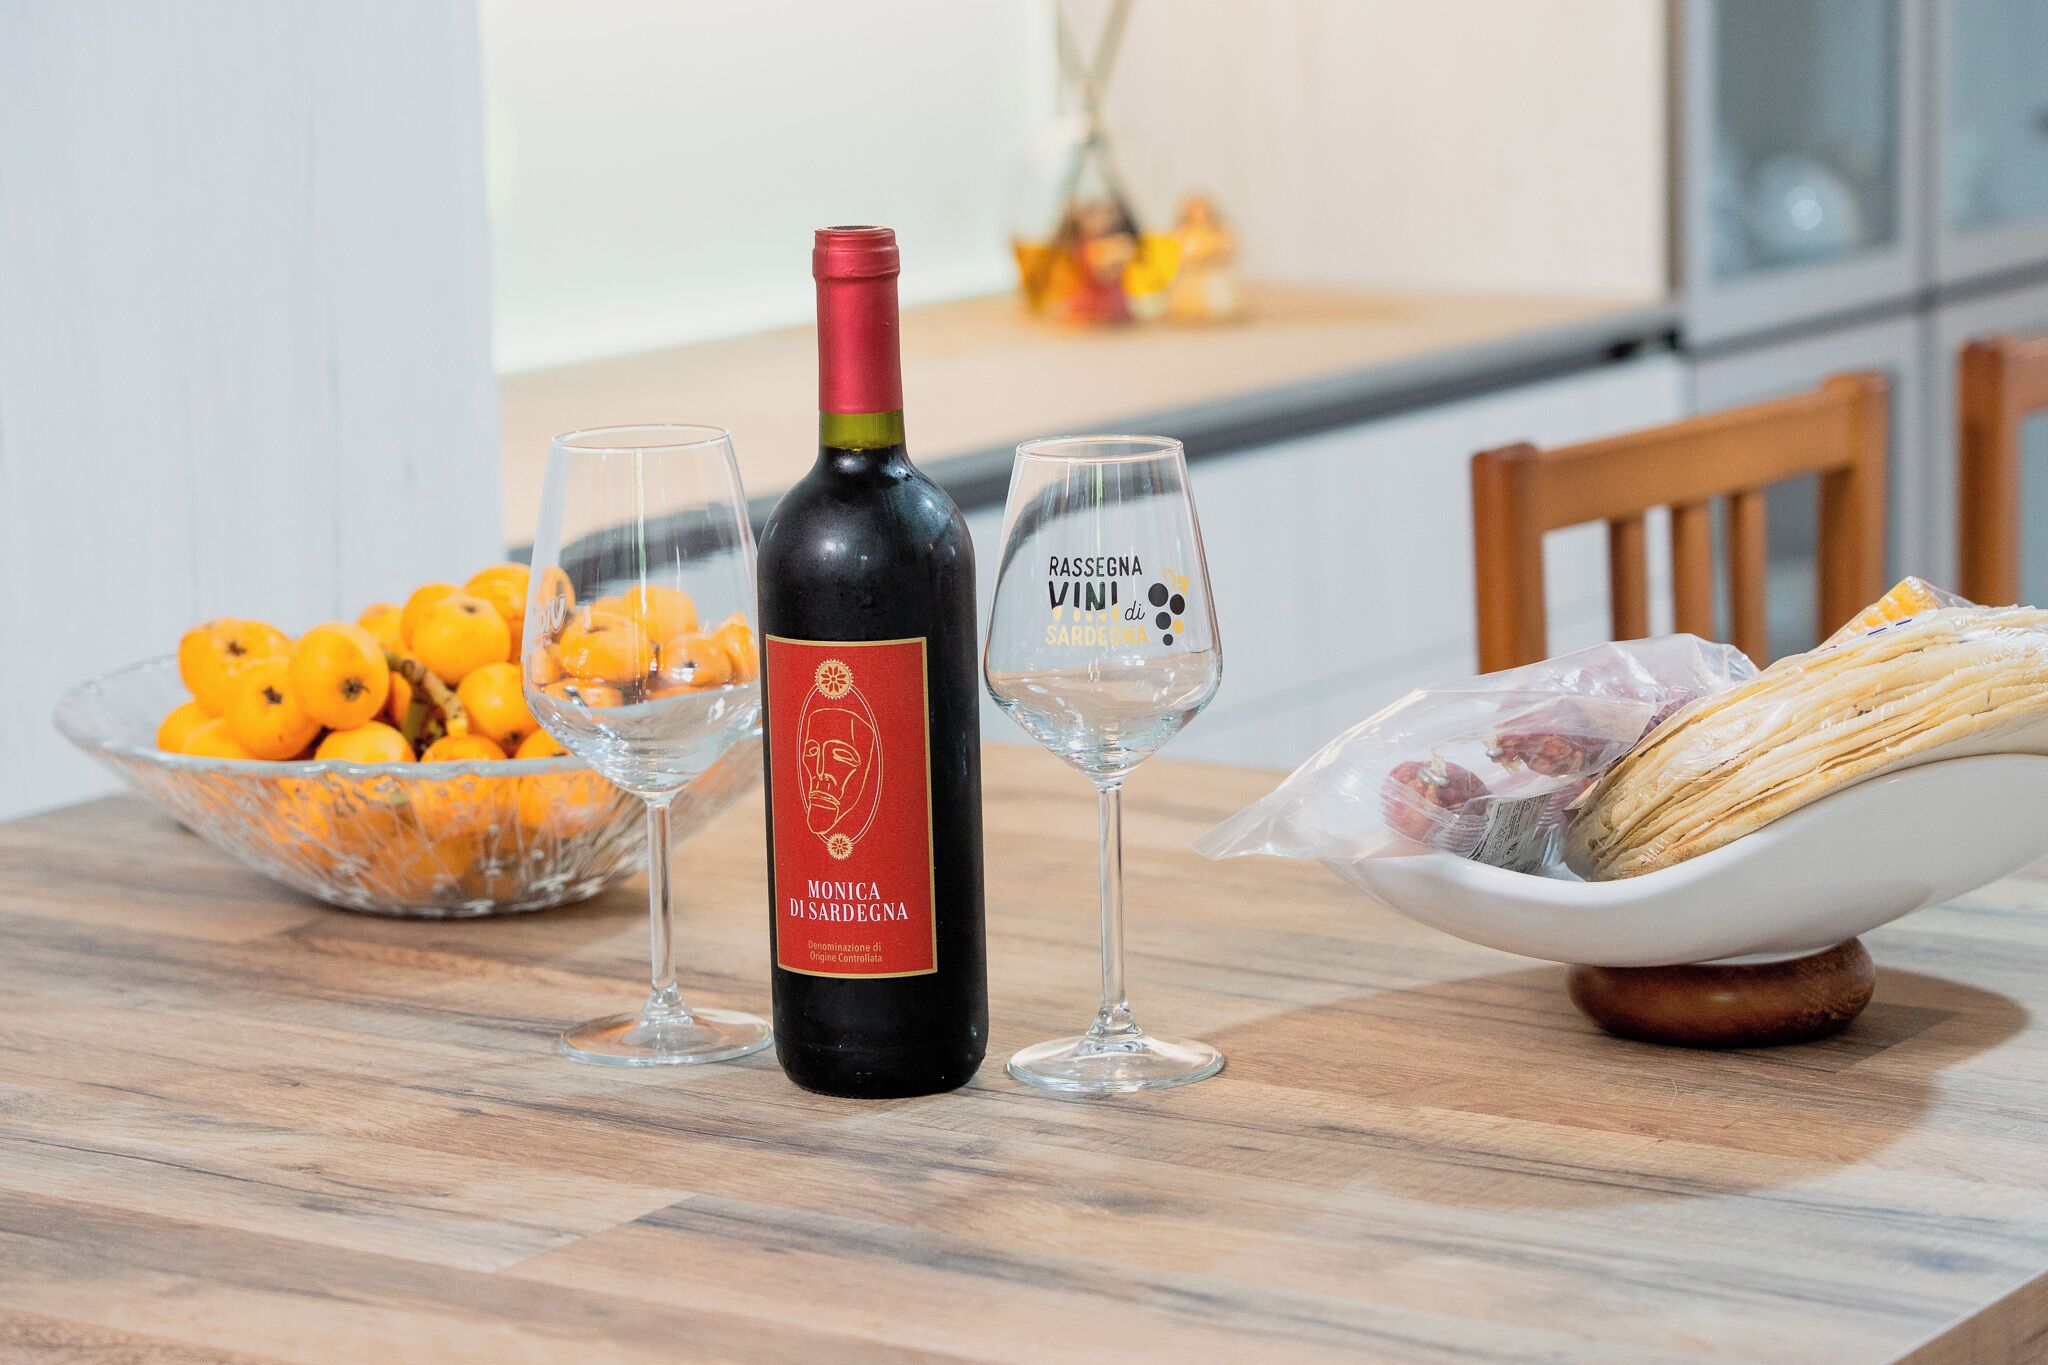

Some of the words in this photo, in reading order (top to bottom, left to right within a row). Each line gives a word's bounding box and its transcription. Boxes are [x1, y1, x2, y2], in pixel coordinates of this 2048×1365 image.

[1049, 555, 1143, 577] RASSEGNA
[1048, 580, 1120, 622] VINI
[1125, 600, 1146, 621] di
[1045, 624, 1148, 646] SARDEGNA
[808, 879, 881, 900] MONICA
[790, 898, 804, 918] DI
[808, 901, 909, 922] SARDEGNA
[808, 940, 871, 953] Denominazione
[873, 941, 881, 952] di
[809, 951, 837, 964] Origine
[838, 953, 882, 963] Controllata
